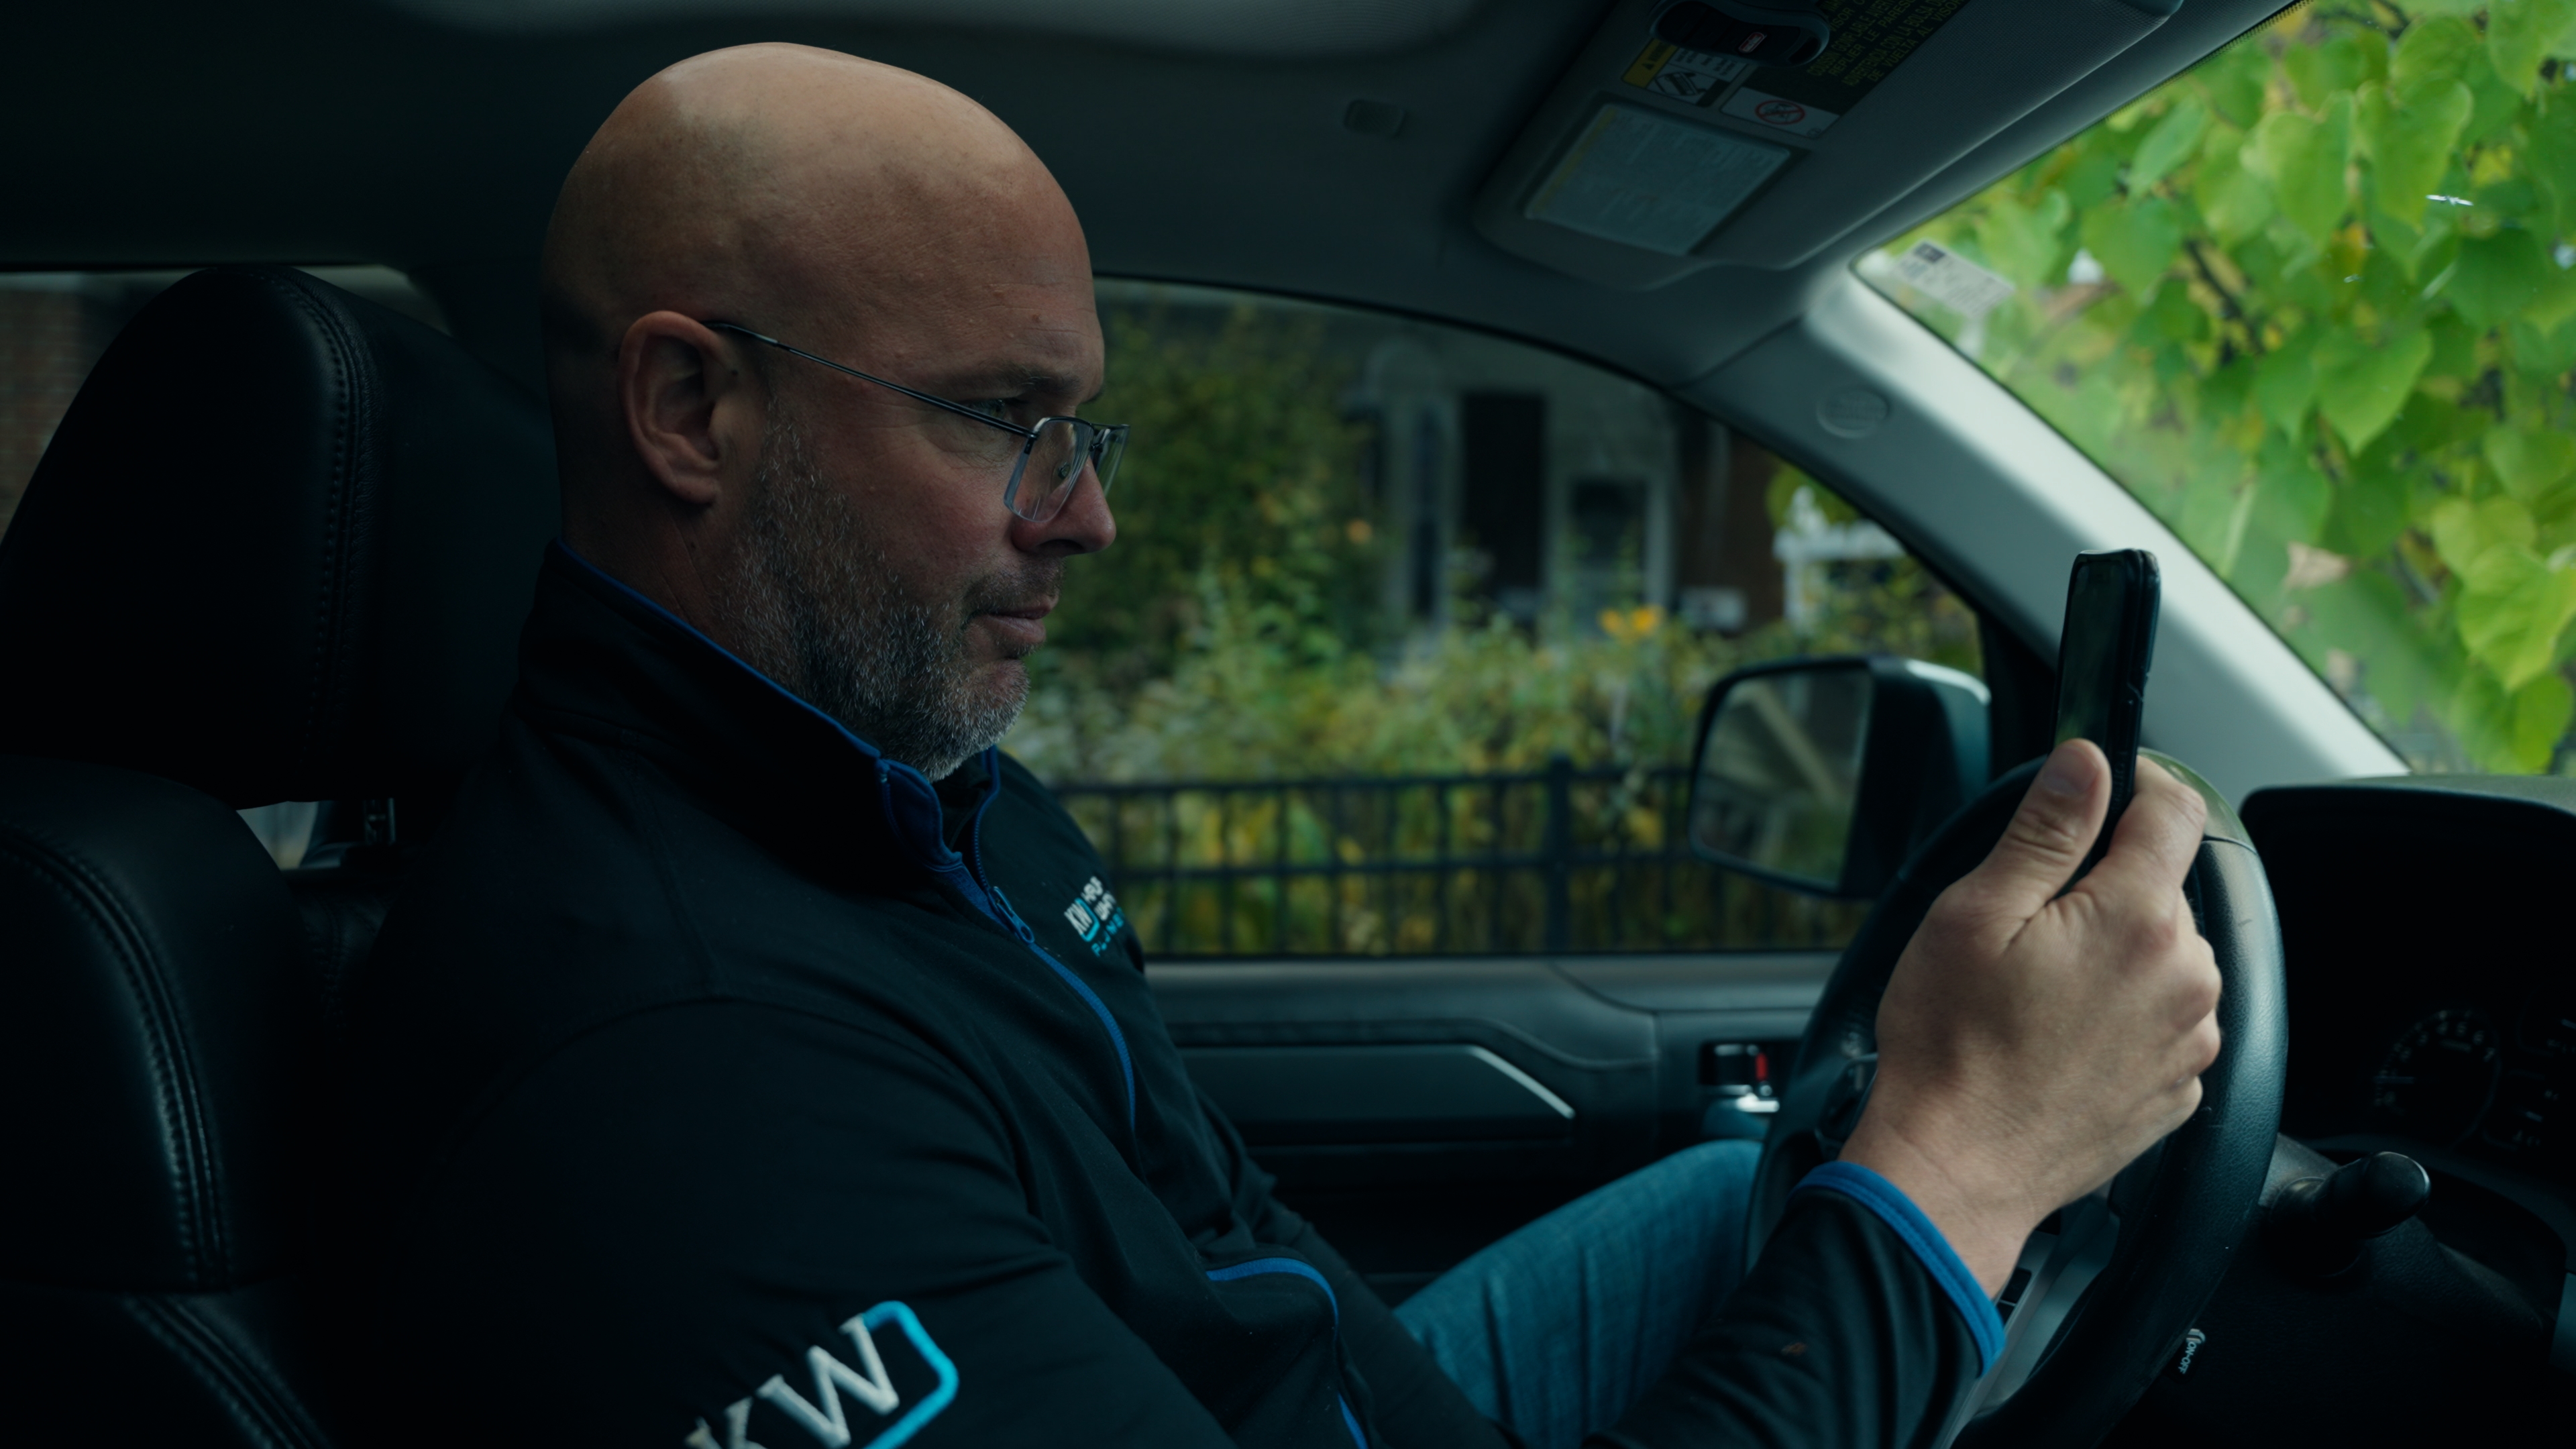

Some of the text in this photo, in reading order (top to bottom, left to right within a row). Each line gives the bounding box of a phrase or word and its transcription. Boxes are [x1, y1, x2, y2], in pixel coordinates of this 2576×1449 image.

[1831, 15, 1876, 52] GONFLABLE
[1894, 25, 1915, 36] LA
[1902, 5, 1936, 27] BOLSA
[1827, 44, 1866, 76] REPLIER
[1863, 30, 1880, 42] LE
[1866, 68, 1884, 81] DE
[1882, 38, 1919, 66] VUELTA
[1916, 25, 1934, 37] AL
[1880, 34, 1905, 50] CON
[1841, 48, 1891, 86] ADVERTENCIA
[2178, 1341, 2197, 1375] ON-OFF
